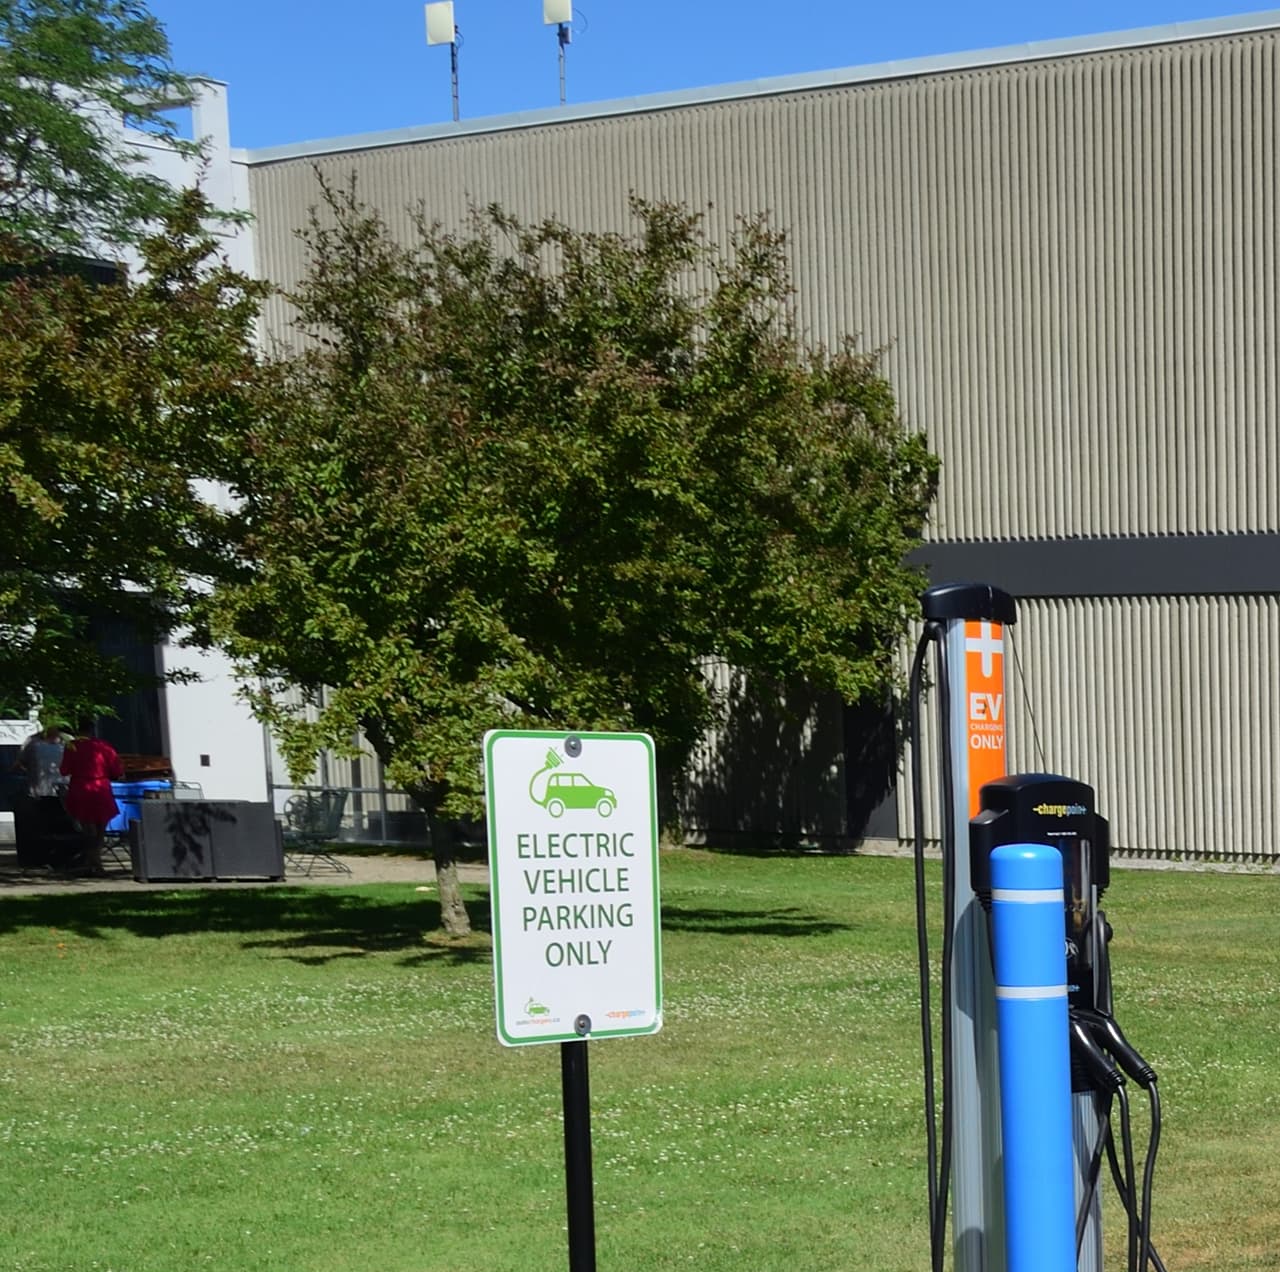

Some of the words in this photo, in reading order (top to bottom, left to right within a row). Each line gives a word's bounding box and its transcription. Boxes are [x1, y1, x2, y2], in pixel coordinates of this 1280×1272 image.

[970, 692, 1003, 721] EV
[970, 734, 1004, 750] ONLY
[516, 832, 635, 859] ELECTRIC
[523, 867, 630, 895] VEHICLE
[522, 903, 633, 931] PARKING
[545, 940, 613, 967] ONLY
